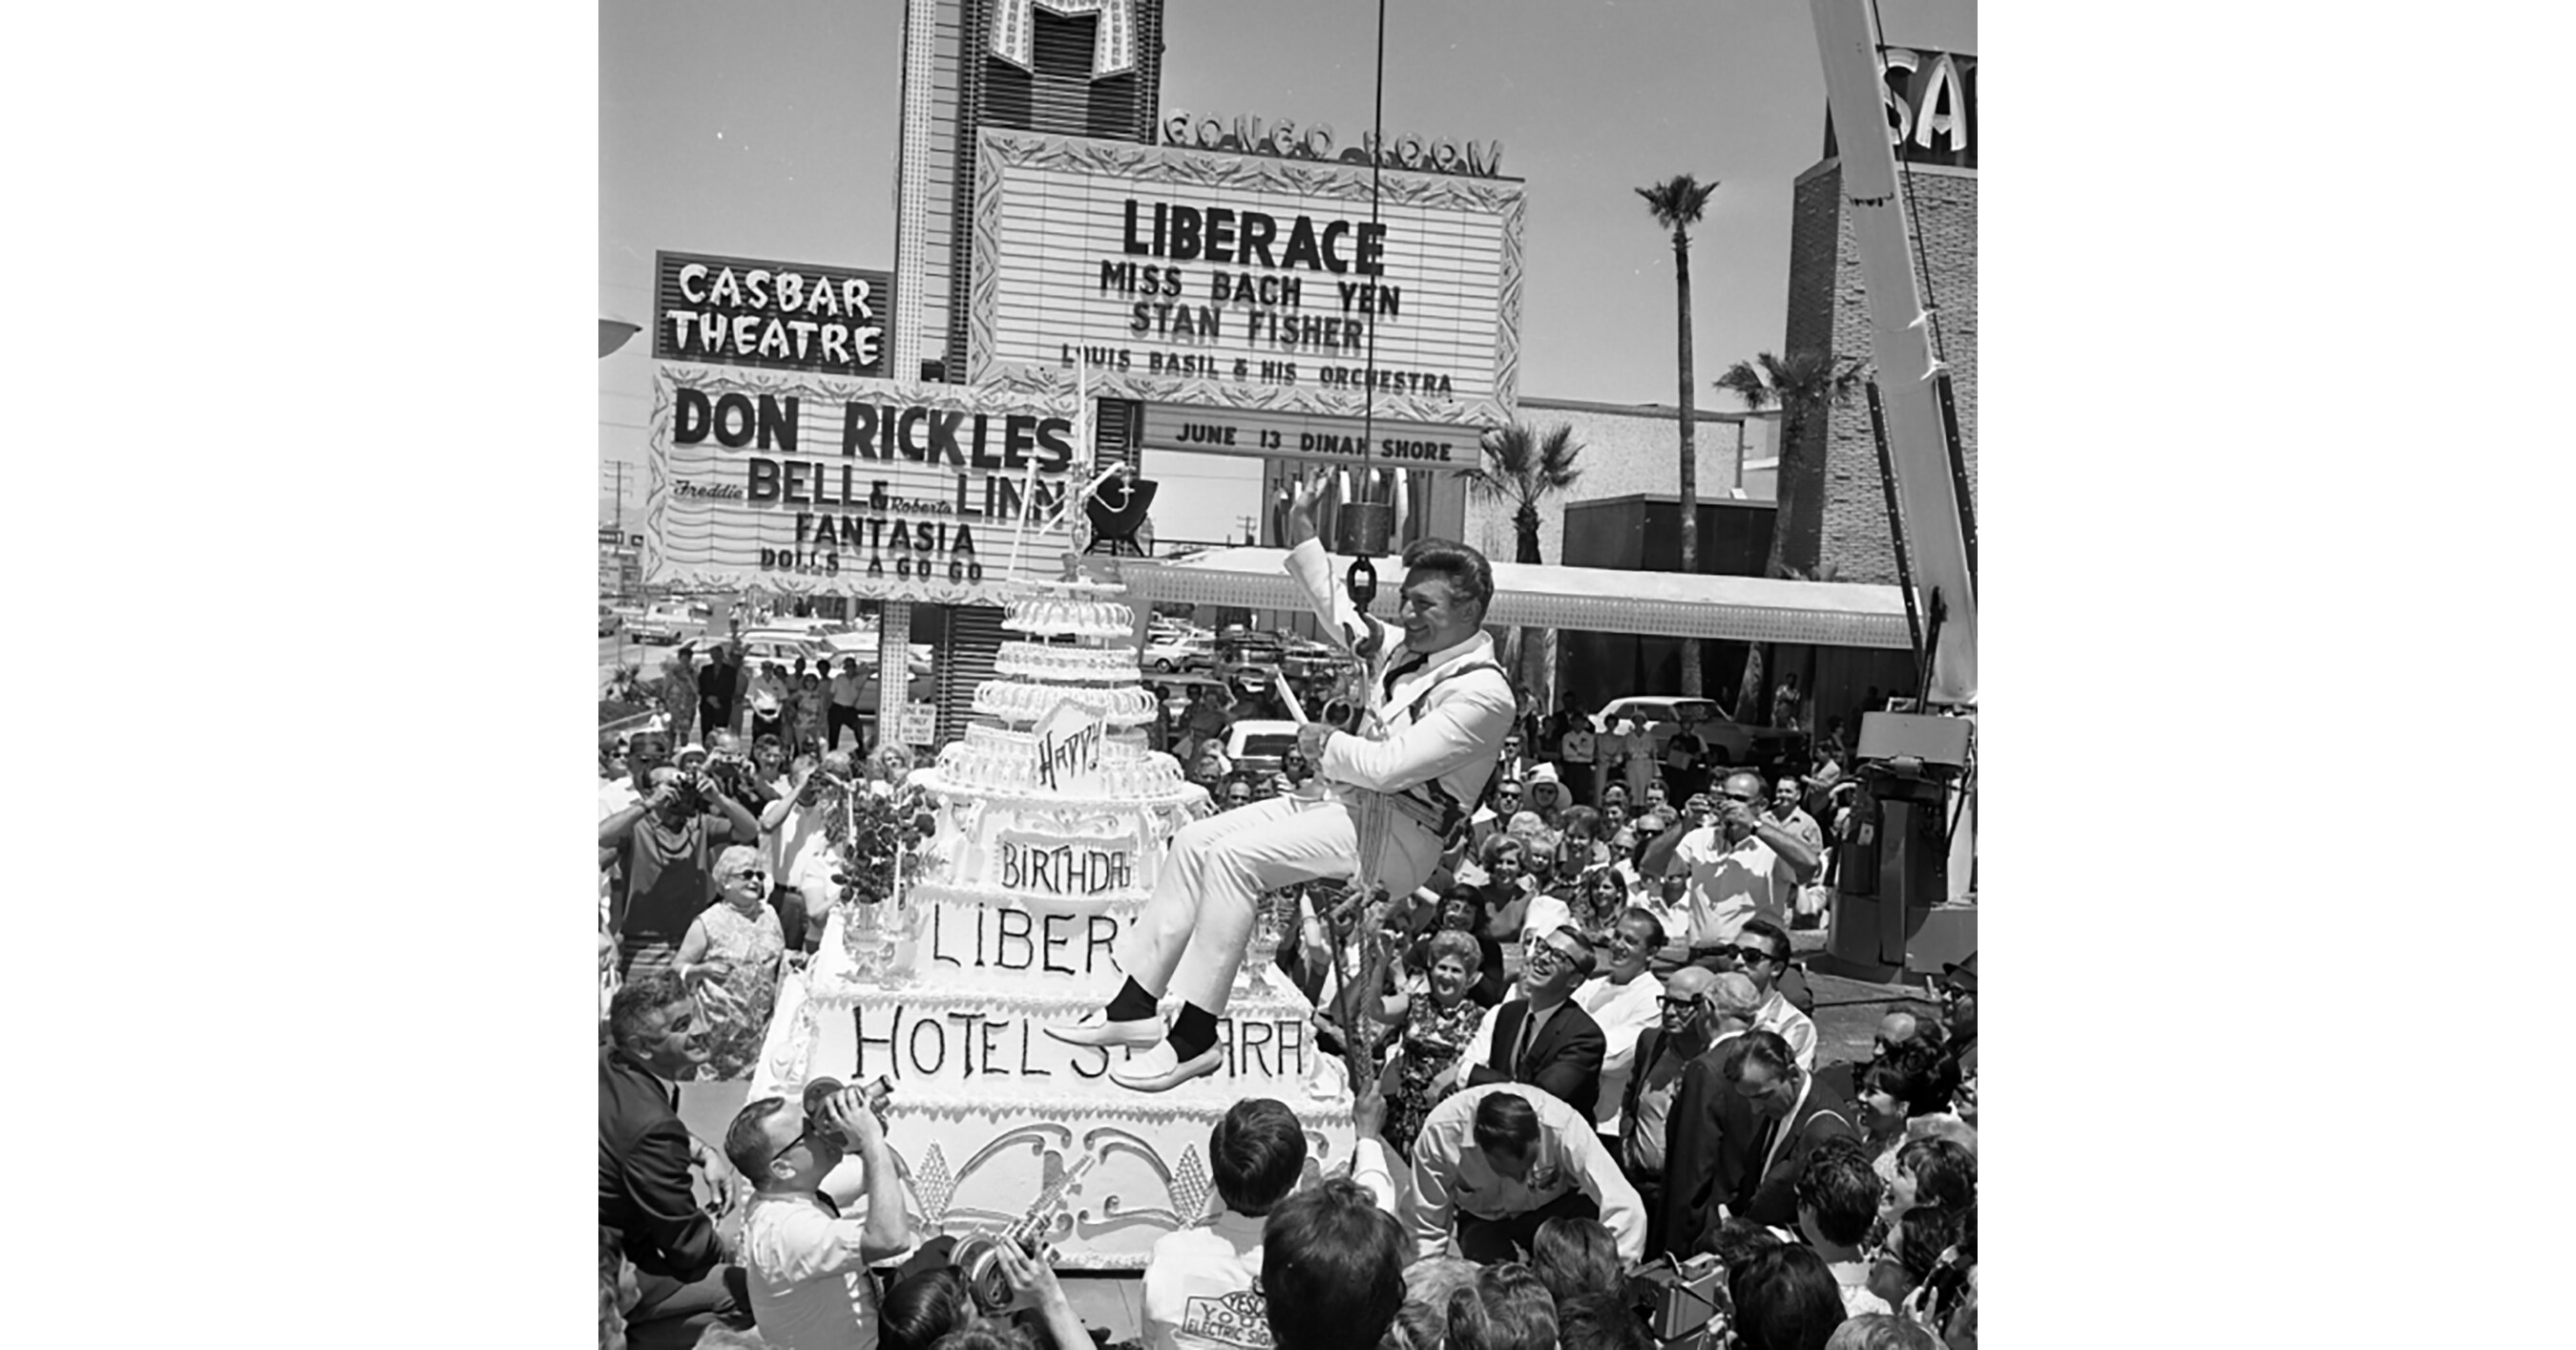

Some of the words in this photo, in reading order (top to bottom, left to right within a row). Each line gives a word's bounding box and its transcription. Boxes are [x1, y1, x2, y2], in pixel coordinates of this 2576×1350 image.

[1876, 48, 1977, 152] SA
[1163, 107, 1333, 159] CONGO
[1363, 129, 1504, 177] ROOM
[1123, 200, 1388, 276] LIBERACE
[678, 264, 874, 319] CASBAR
[1100, 259, 1183, 297] MISS
[1211, 269, 1302, 308] BACH
[1338, 281, 1400, 316] YEN
[666, 309, 883, 366] THEATRE
[1130, 303, 1221, 338] STAN
[1248, 311, 1365, 349] FISHER
[1149, 350, 1220, 378] BASIL
[1232, 357, 1248, 379] &
[1261, 360, 1297, 383] HIS
[1320, 366, 1454, 396] ORCHESTRA
[675, 387, 799, 452] DON
[843, 401, 1073, 473] RICKLES
[1176, 423, 1238, 446] JUNE
[1260, 429, 1281, 450] 13
[1299, 432, 1372, 456] DINAH
[1380, 438, 1454, 462] SHORE
[673, 479, 744, 500] Freddie
[747, 457, 869, 507] BELL
[890, 496, 953, 515] Roberta
[956, 474, 1066, 522] LINN
[796, 512, 975, 555] FANTASIA
[762, 548, 839, 572] DOLLS
[868, 556, 884, 574] A
[896, 558, 932, 576] GO
[949, 560, 983, 580] GO
[933, 902, 1138, 975] LIBER
[851, 1004, 1052, 1080] HOTEL
[1187, 1318, 1244, 1342] ELECTRIC
